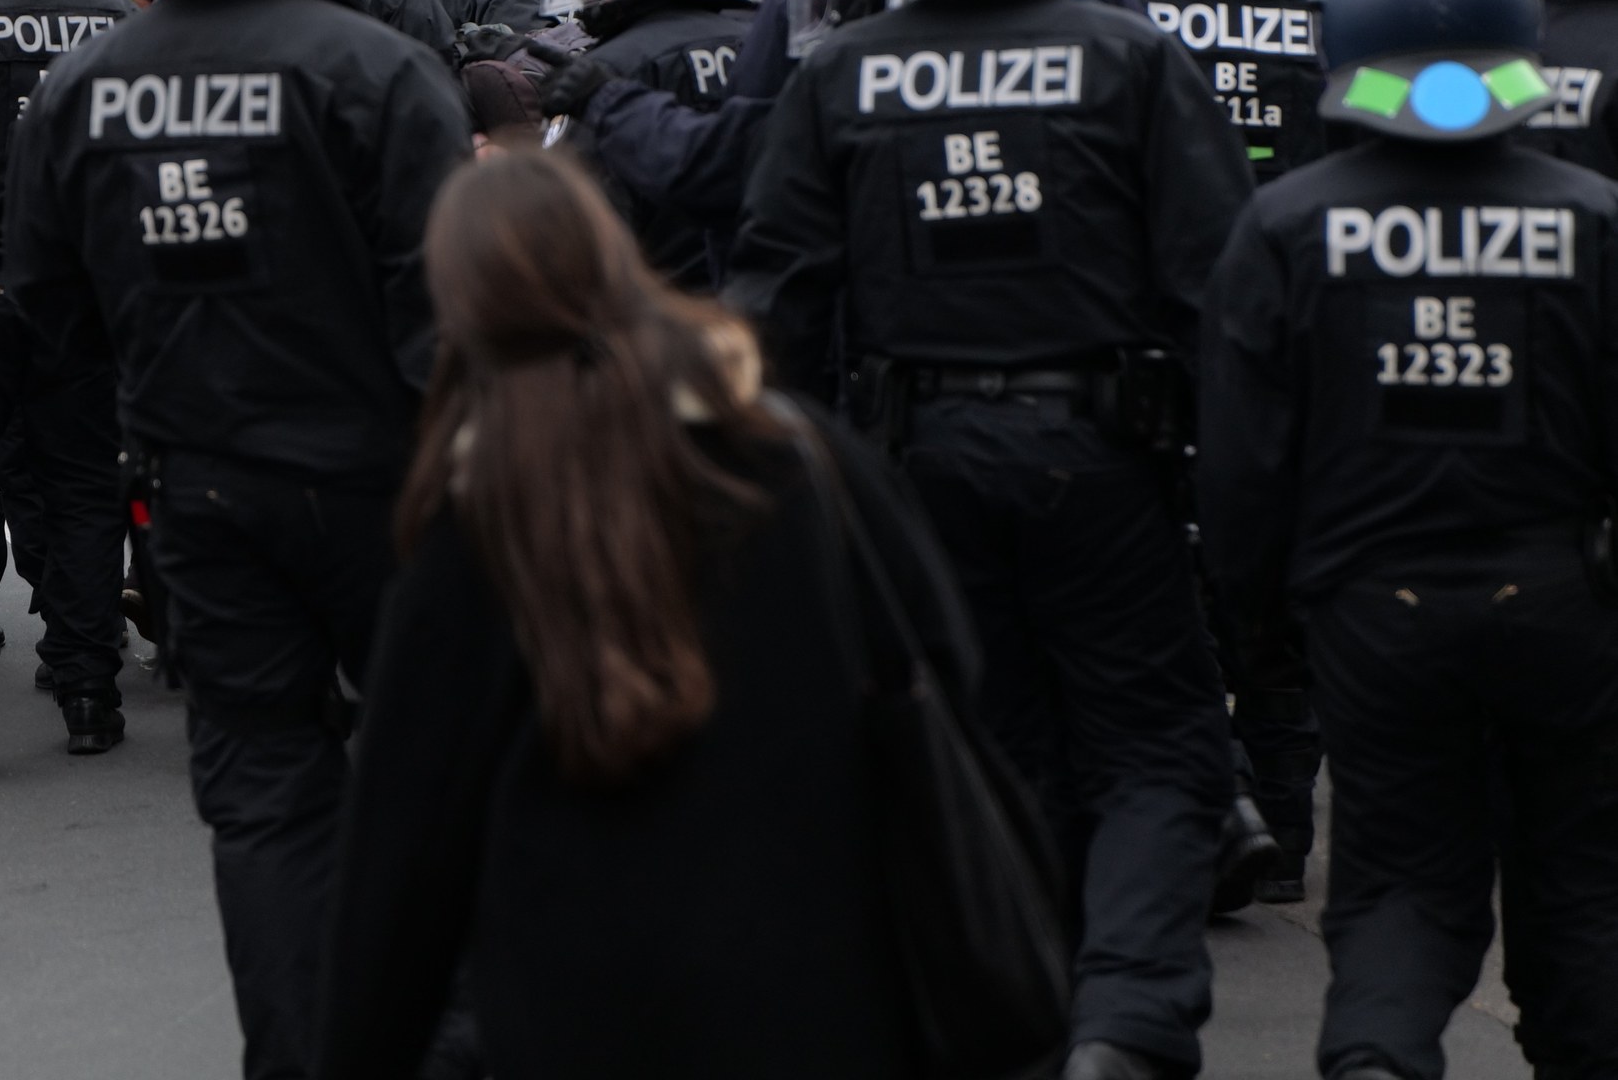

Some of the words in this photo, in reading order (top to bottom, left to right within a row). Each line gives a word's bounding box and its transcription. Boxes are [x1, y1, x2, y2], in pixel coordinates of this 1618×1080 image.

[858, 45, 1082, 113] POLIZEI
[1215, 62, 1258, 92] BE
[89, 73, 280, 139] POLIZEI
[1213, 95, 1282, 127] 11a
[944, 130, 1003, 175] BE
[158, 159, 212, 202] BE
[916, 171, 1042, 220] 12328
[139, 197, 248, 245] 12326
[1326, 205, 1574, 278] POLIZEI
[1413, 296, 1476, 340] BE
[1376, 343, 1513, 386] 12323
